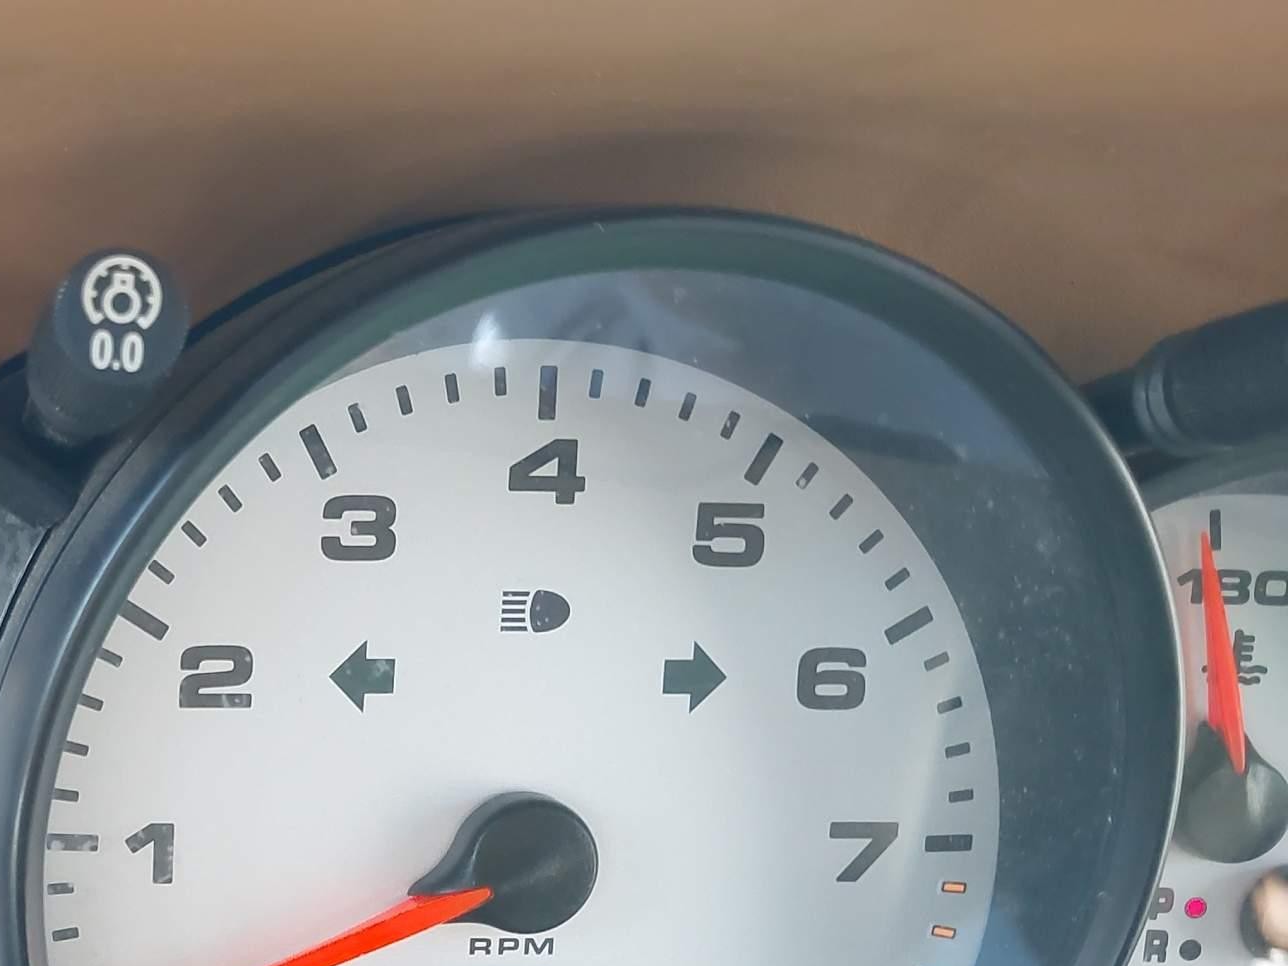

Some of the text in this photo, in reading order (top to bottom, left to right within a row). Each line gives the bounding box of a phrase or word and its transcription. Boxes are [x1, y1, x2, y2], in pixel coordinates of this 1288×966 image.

[91, 328, 144, 373] 0.0
[508, 438, 586, 504] 4
[320, 494, 397, 562] 3
[692, 502, 766, 568] 5
[179, 645, 253, 708] 2
[796, 647, 867, 711] 6
[125, 822, 175, 884] 1
[829, 822, 900, 883] 7
[1149, 888, 1175, 920] P
[469, 936, 555, 957] RPM
[1143, 929, 1169, 963] R
